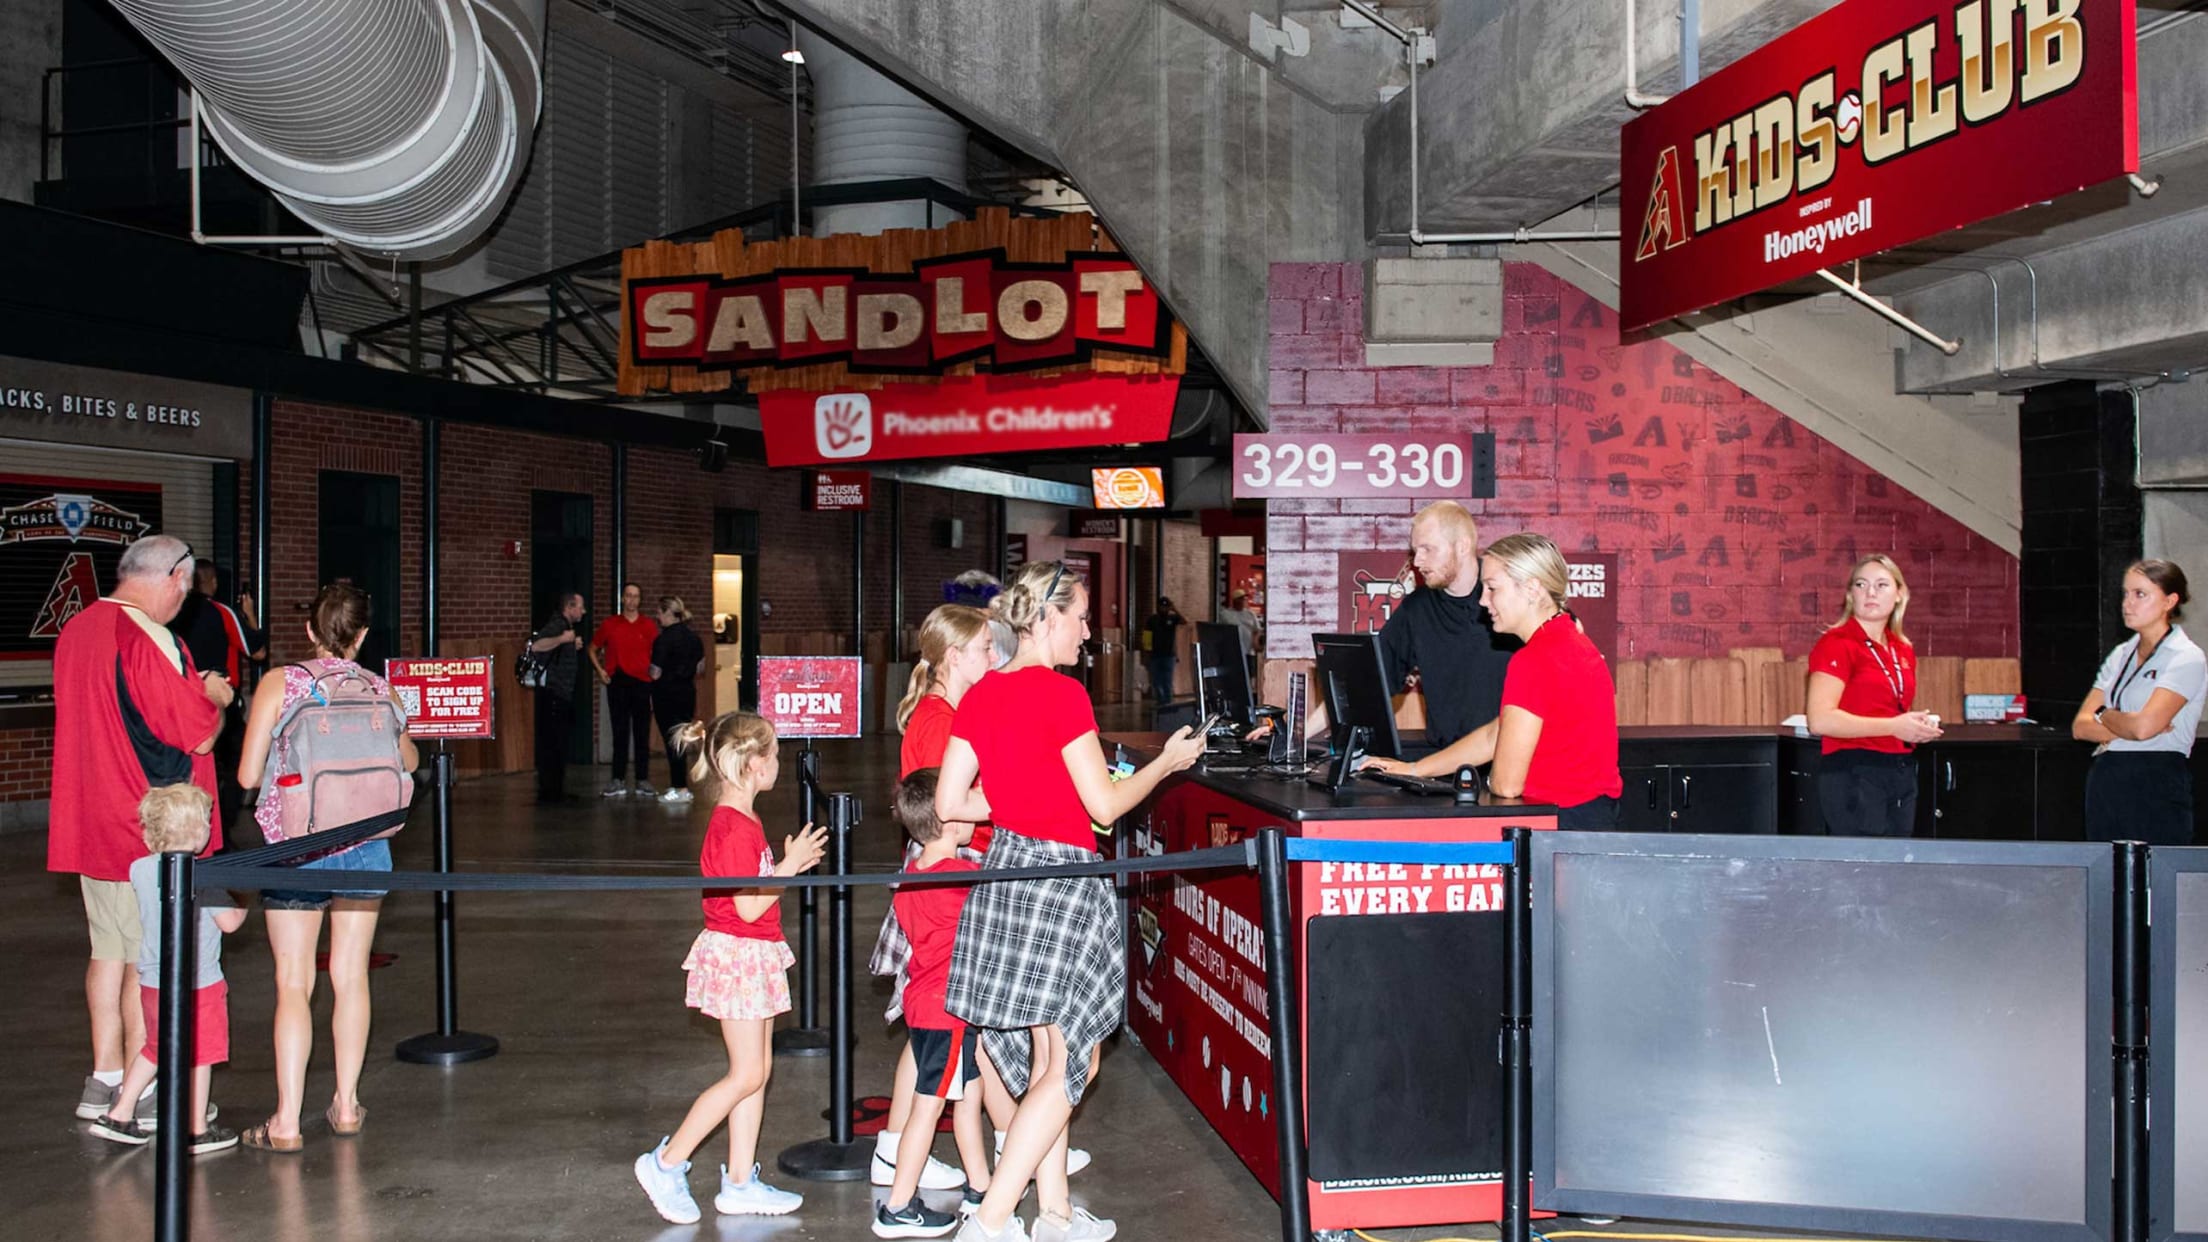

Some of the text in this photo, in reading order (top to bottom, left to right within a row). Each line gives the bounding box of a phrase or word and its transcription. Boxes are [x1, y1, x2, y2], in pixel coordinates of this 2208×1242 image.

[1695, 0, 2086, 234] KIDS CLUB
[1764, 197, 1872, 263] Honeywell
[643, 270, 1144, 353] SANDLOT
[62, 395, 117, 417] BITES
[126, 402, 138, 420] &
[147, 405, 201, 427] BEERS
[883, 405, 1115, 436] Phoenix Children's
[1243, 443, 1463, 488] 329-330
[817, 485, 861, 495] INCLUSIVE
[817, 495, 863, 505] RESTROOM
[10, 513, 133, 530] CHASE FIELD
[1567, 564, 1605, 580] ZES
[1566, 582, 1605, 598] AME!
[409, 662, 484, 676] KIDS CLUB
[426, 686, 454, 696] SCAN
[456, 686, 483, 696] CODE
[426, 696, 483, 707] TO SIGN UP
[430, 707, 480, 717] FOR FREE
[775, 692, 842, 714] OPEN
[1321, 862, 1502, 883] FREE PRIZ
[1174, 873, 1204, 926] HOURS
[1207, 895, 1220, 936] OF
[1321, 886, 1433, 915] EVERY
[1187, 931, 1207, 968] GATES
[1208, 947, 1226, 983] OPEN
[1174, 956, 1186, 982] KIDS
[1185, 966, 1200, 996] MUST
[1200, 979, 1209, 1003] BE
[1208, 986, 1234, 1026] PRESENT
[1234, 1008, 1244, 1035] TO
